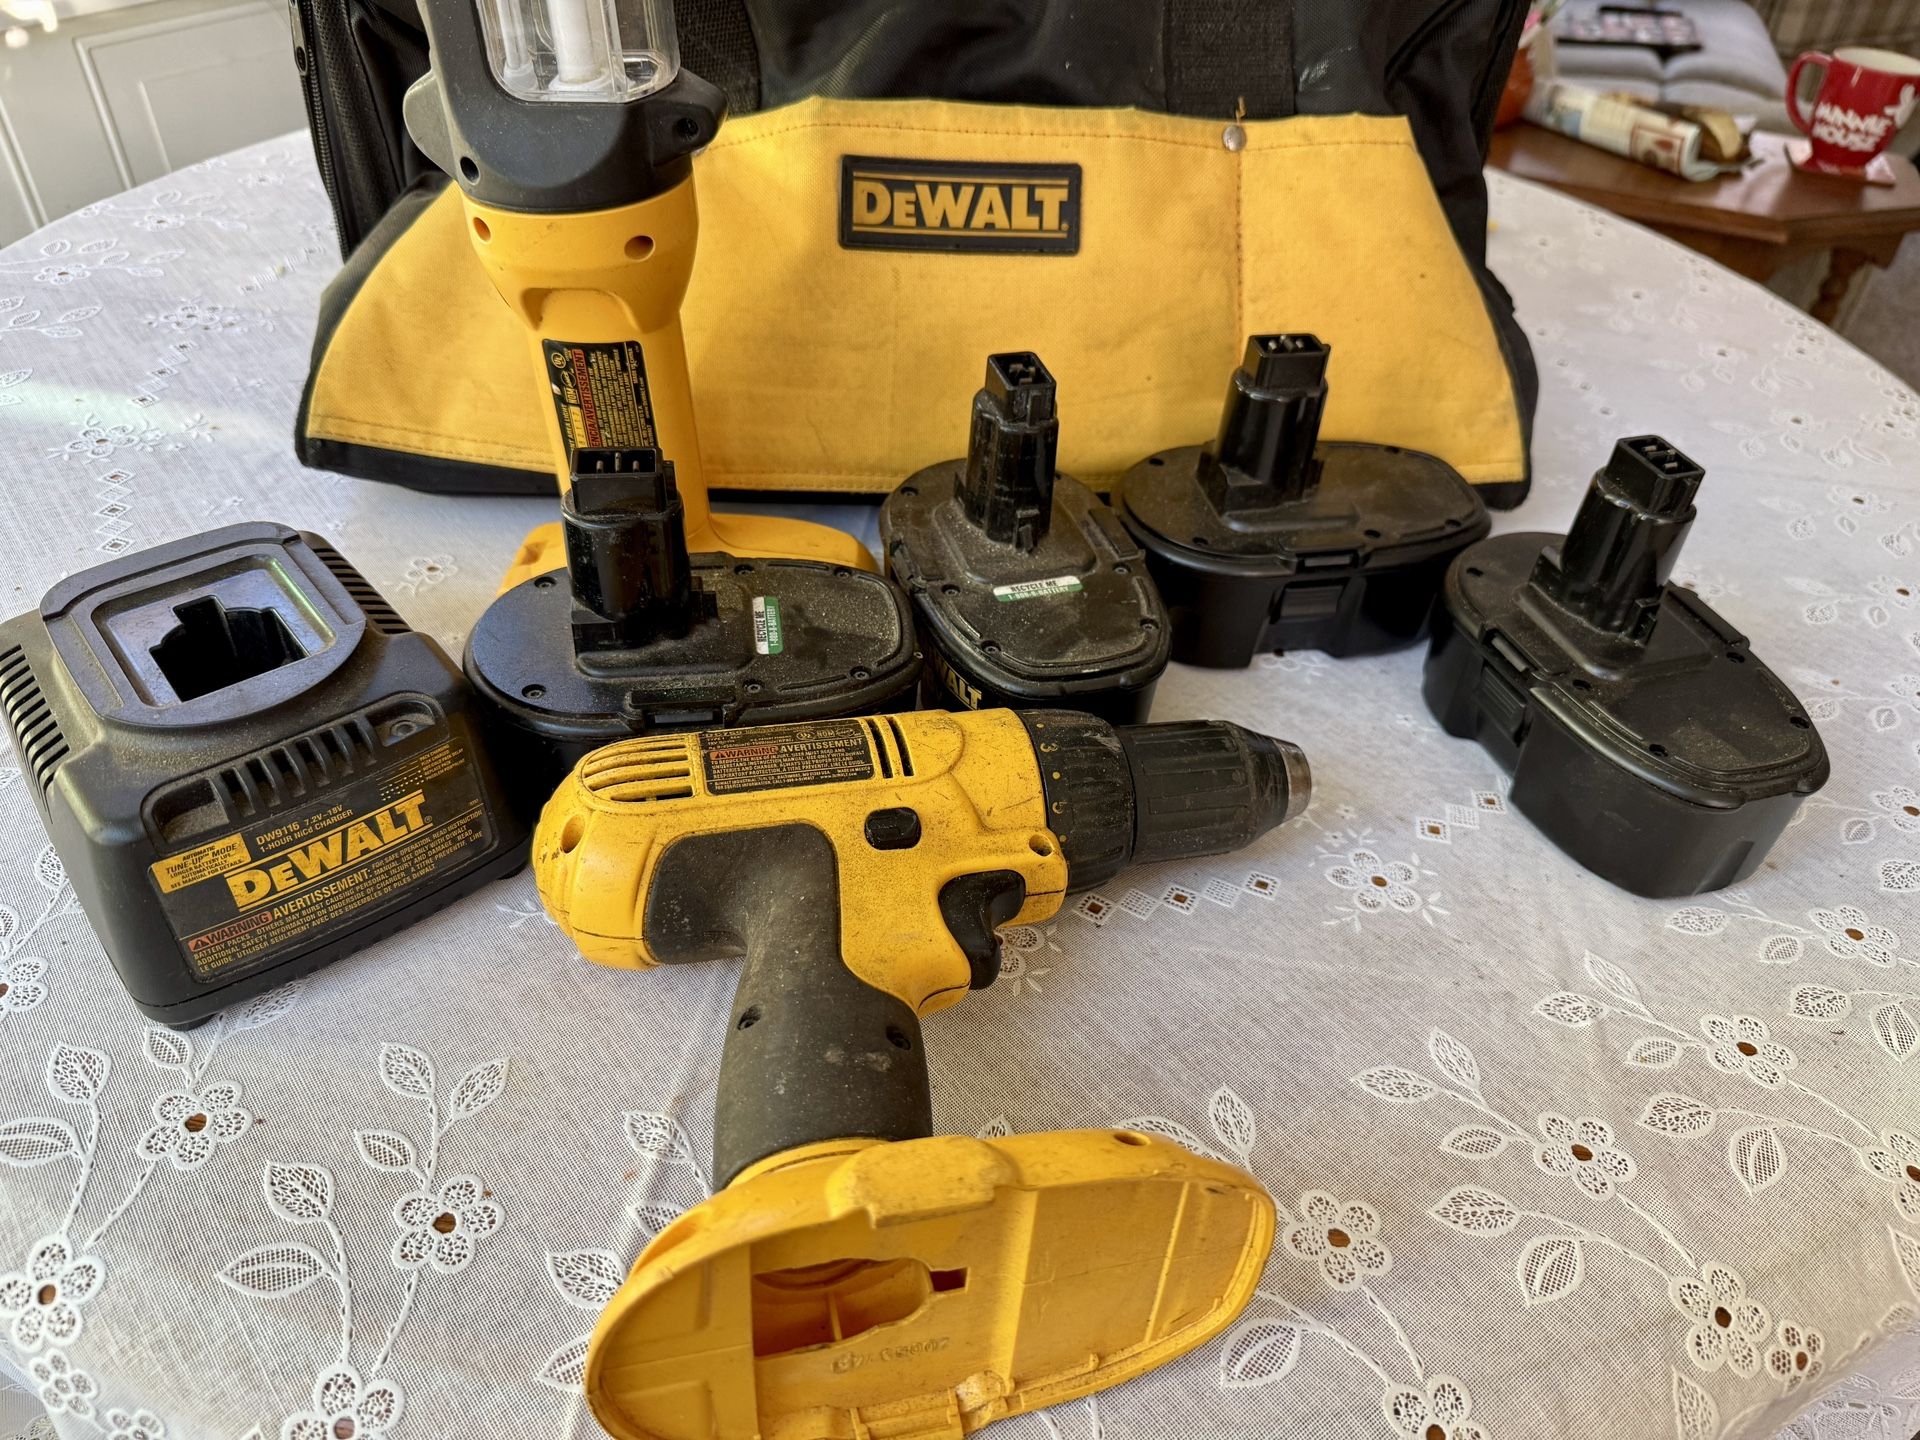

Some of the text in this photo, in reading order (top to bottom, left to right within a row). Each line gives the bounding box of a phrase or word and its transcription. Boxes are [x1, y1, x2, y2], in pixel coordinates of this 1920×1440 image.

[573, 351, 600, 446] ENCIA/AVERTISSEMENT
[1010, 580, 1057, 592] RECYCLE ME
[724, 746, 778, 757] WARNING
[779, 737, 864, 752] AVERTISSEMENT
[255, 820, 300, 846] DW9116
[259, 808, 353, 853] 1-HOUR NiCd CHARGER
[181, 845, 215, 860] AUTOMATIC
[210, 843, 237, 857] MODE
[401, 852, 413, 862] USE
[414, 843, 429, 855] ONLY
[429, 835, 445, 848] WITH
[193, 856, 220, 870] BATTERY
[181, 871, 206, 884] MANUAL
[193, 942, 225, 960] BATTERY
[255, 918, 284, 934] OTHERS
[285, 911, 300, 923] MAY
[301, 901, 324, 915] BURST
[324, 887, 354, 905] CAUSING
[355, 871, 389, 891] PERSONAL
[389, 859, 412, 875] INJURY
[413, 852, 426, 863] AND
[456, 828, 472, 842] READ
[271, 866, 372, 919] AVERTISSEMENT:
[196, 944, 240, 966] ADDITIONAL
[240, 932, 267, 948] SAFETY
[268, 912, 315, 937] INFORMATION
[316, 907, 326, 916] ON
[327, 890, 364, 911] UNDERSIDE
[366, 886, 374, 894] OF
[415, 856, 433, 869] TITRE
[199, 965, 209, 973] LE
[236, 939, 269, 958] UTILISER
[269, 922, 310, 945] SEULEMENT
[311, 913, 329, 926] AVEC
[329, 907, 343, 918] DES
[344, 890, 380, 911] ENSEMBLES
[383, 885, 392, 893] DE
[392, 875, 411, 888] PILES
[205, 911, 270, 945] WARNING
